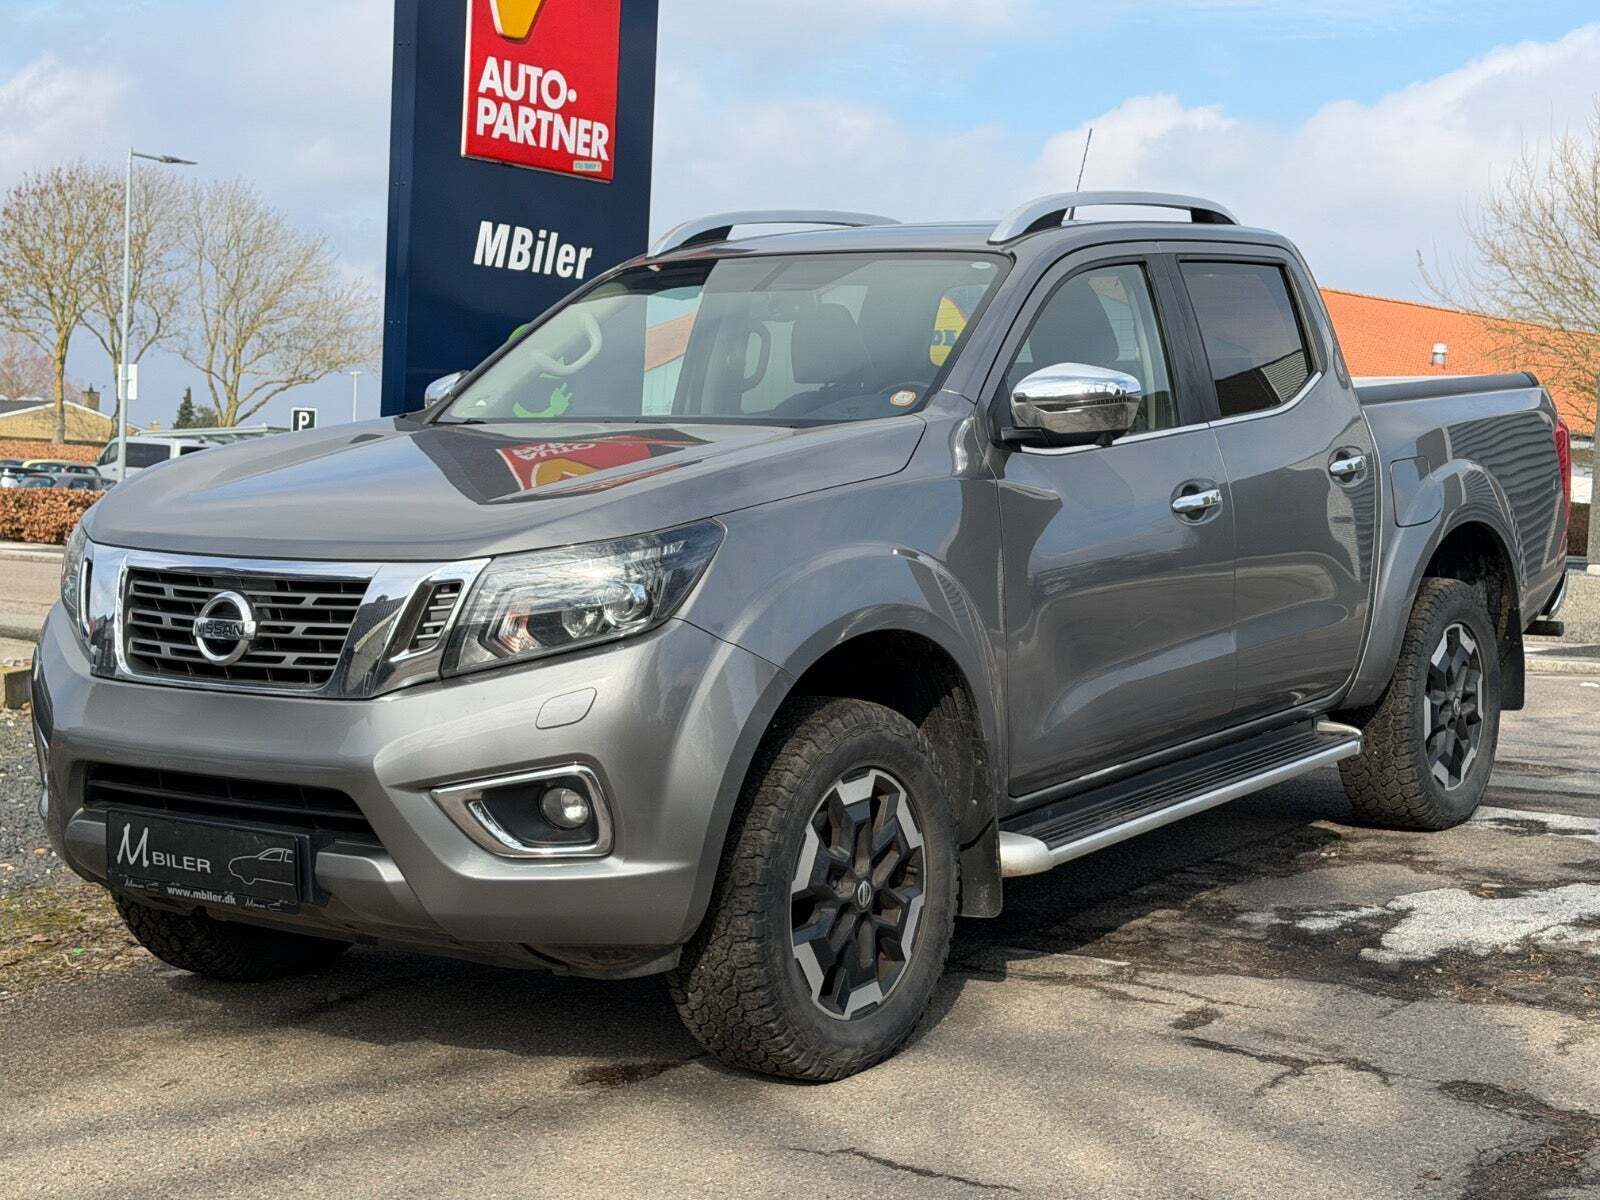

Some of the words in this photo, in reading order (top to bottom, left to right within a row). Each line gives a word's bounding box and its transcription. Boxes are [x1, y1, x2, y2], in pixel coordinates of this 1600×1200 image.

[476, 97, 609, 161] PARTNER
[473, 220, 592, 279] MBiler
[298, 411, 310, 431] P
[198, 621, 244, 636] NISSAN
[166, 885, 236, 905] www.mbiler.dk
